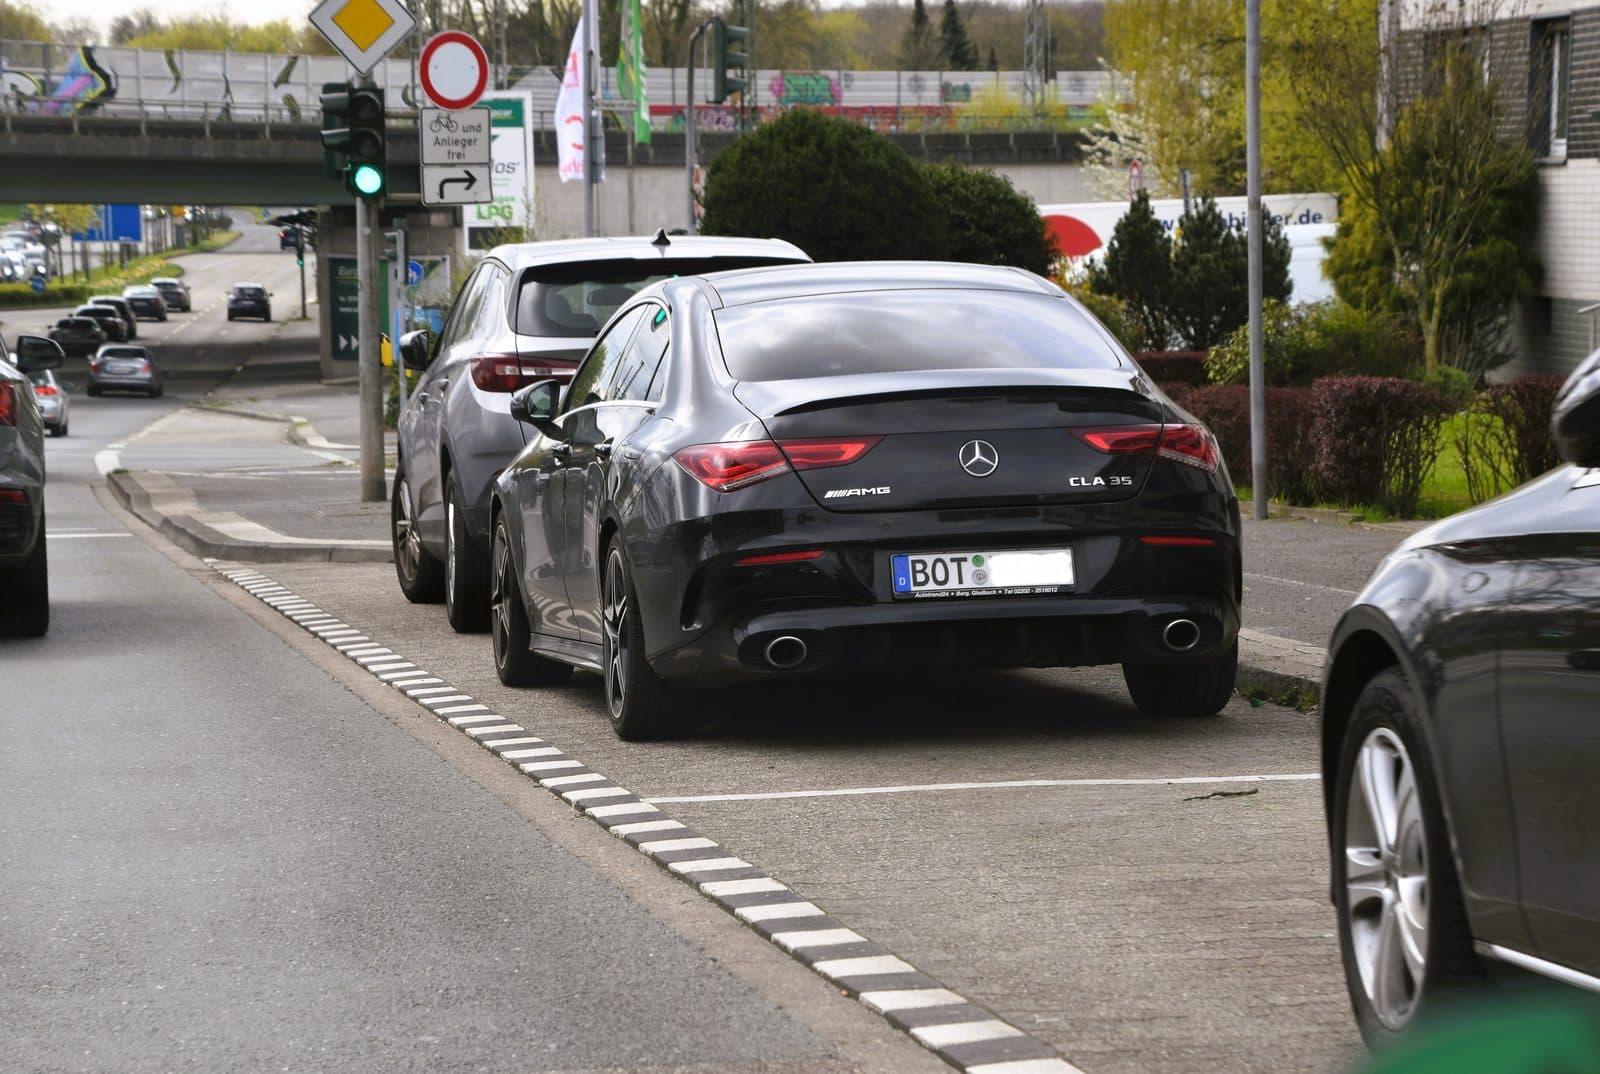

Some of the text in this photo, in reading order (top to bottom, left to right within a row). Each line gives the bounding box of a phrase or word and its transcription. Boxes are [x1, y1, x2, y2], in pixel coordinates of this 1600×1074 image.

[462, 122, 482, 133] und
[433, 136, 479, 149] Anlieger
[447, 149, 466, 160] frei
[1069, 476, 1132, 487] CLA 35
[846, 486, 891, 497] AMG
[911, 557, 968, 587] BOT
[900, 577, 906, 586] D
